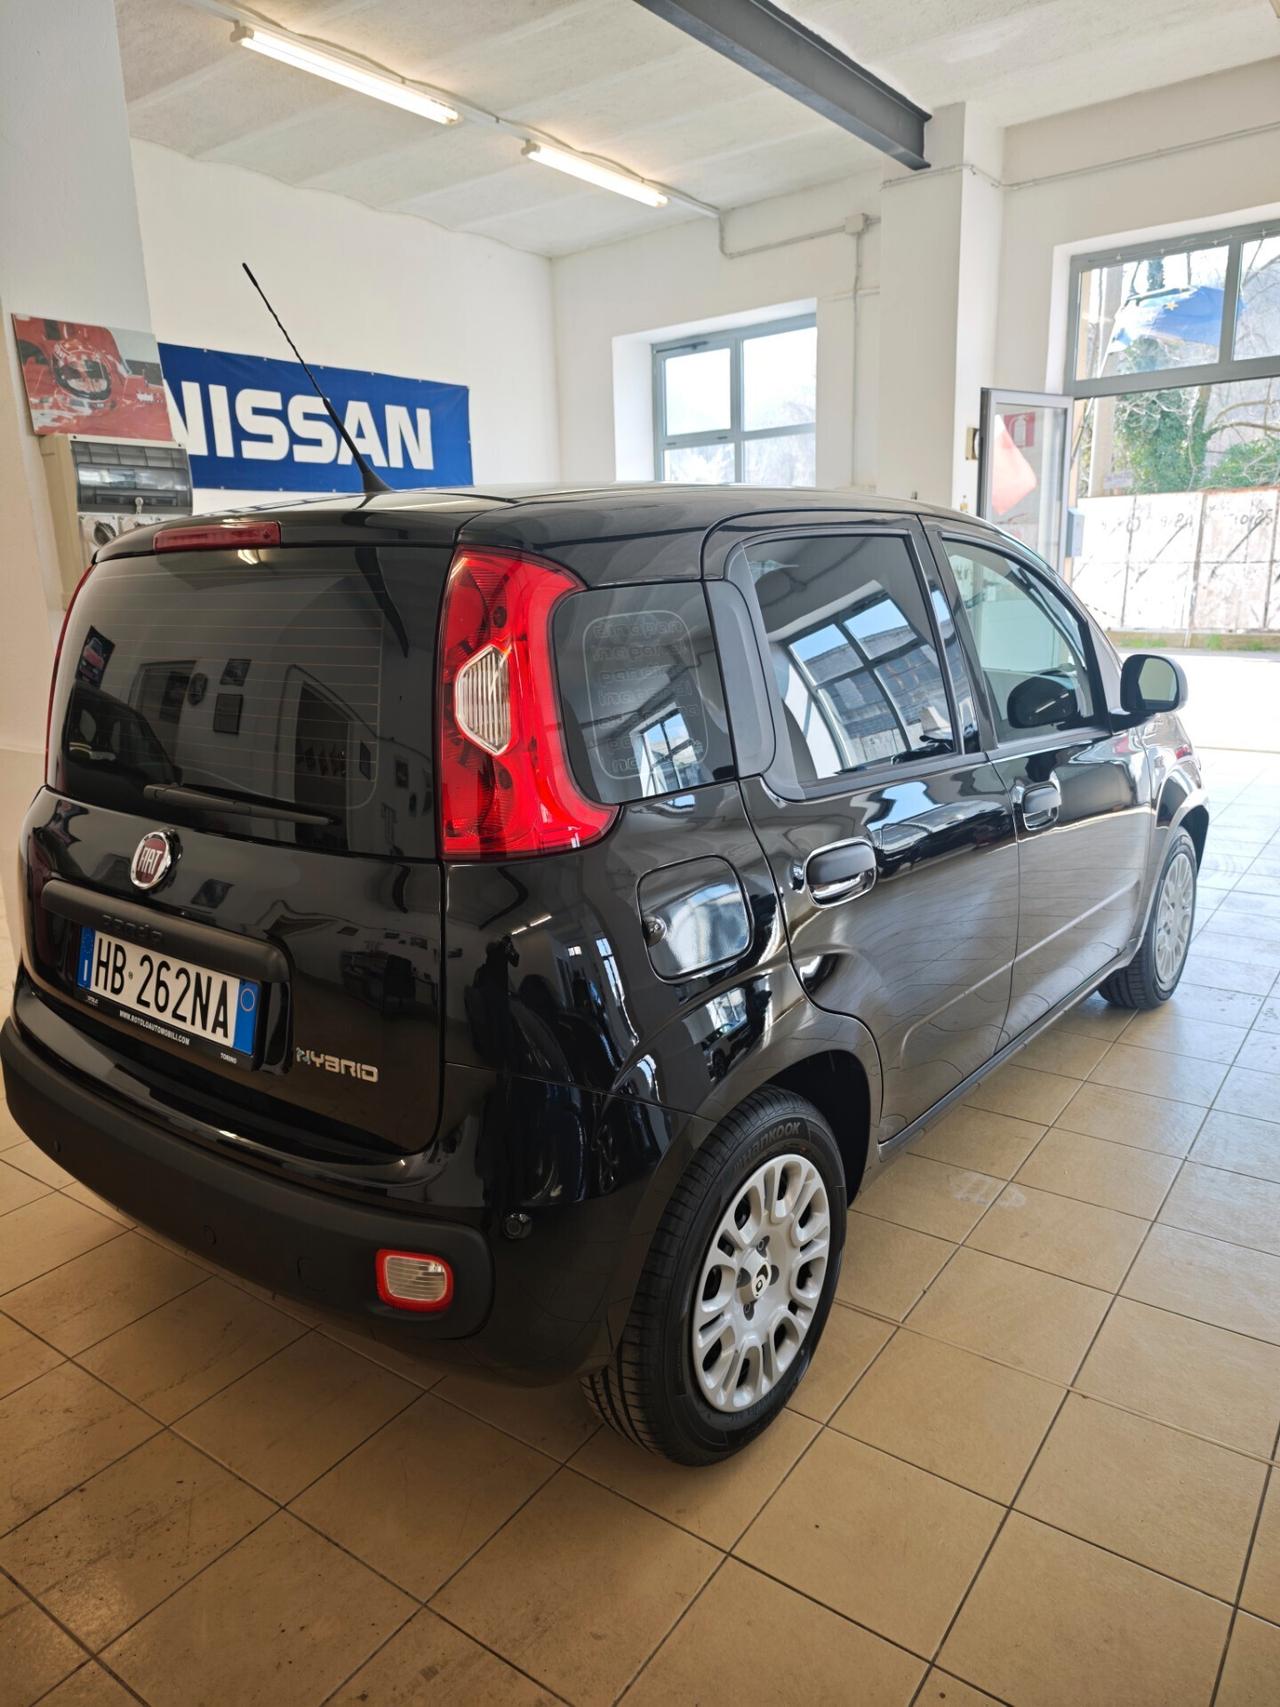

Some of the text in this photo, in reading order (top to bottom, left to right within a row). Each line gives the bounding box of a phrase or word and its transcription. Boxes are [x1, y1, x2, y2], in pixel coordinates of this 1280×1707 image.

[164, 379, 434, 470] NISSAN
[137, 847, 164, 875] FIAT
[94, 938, 229, 1039] HB 262NA
